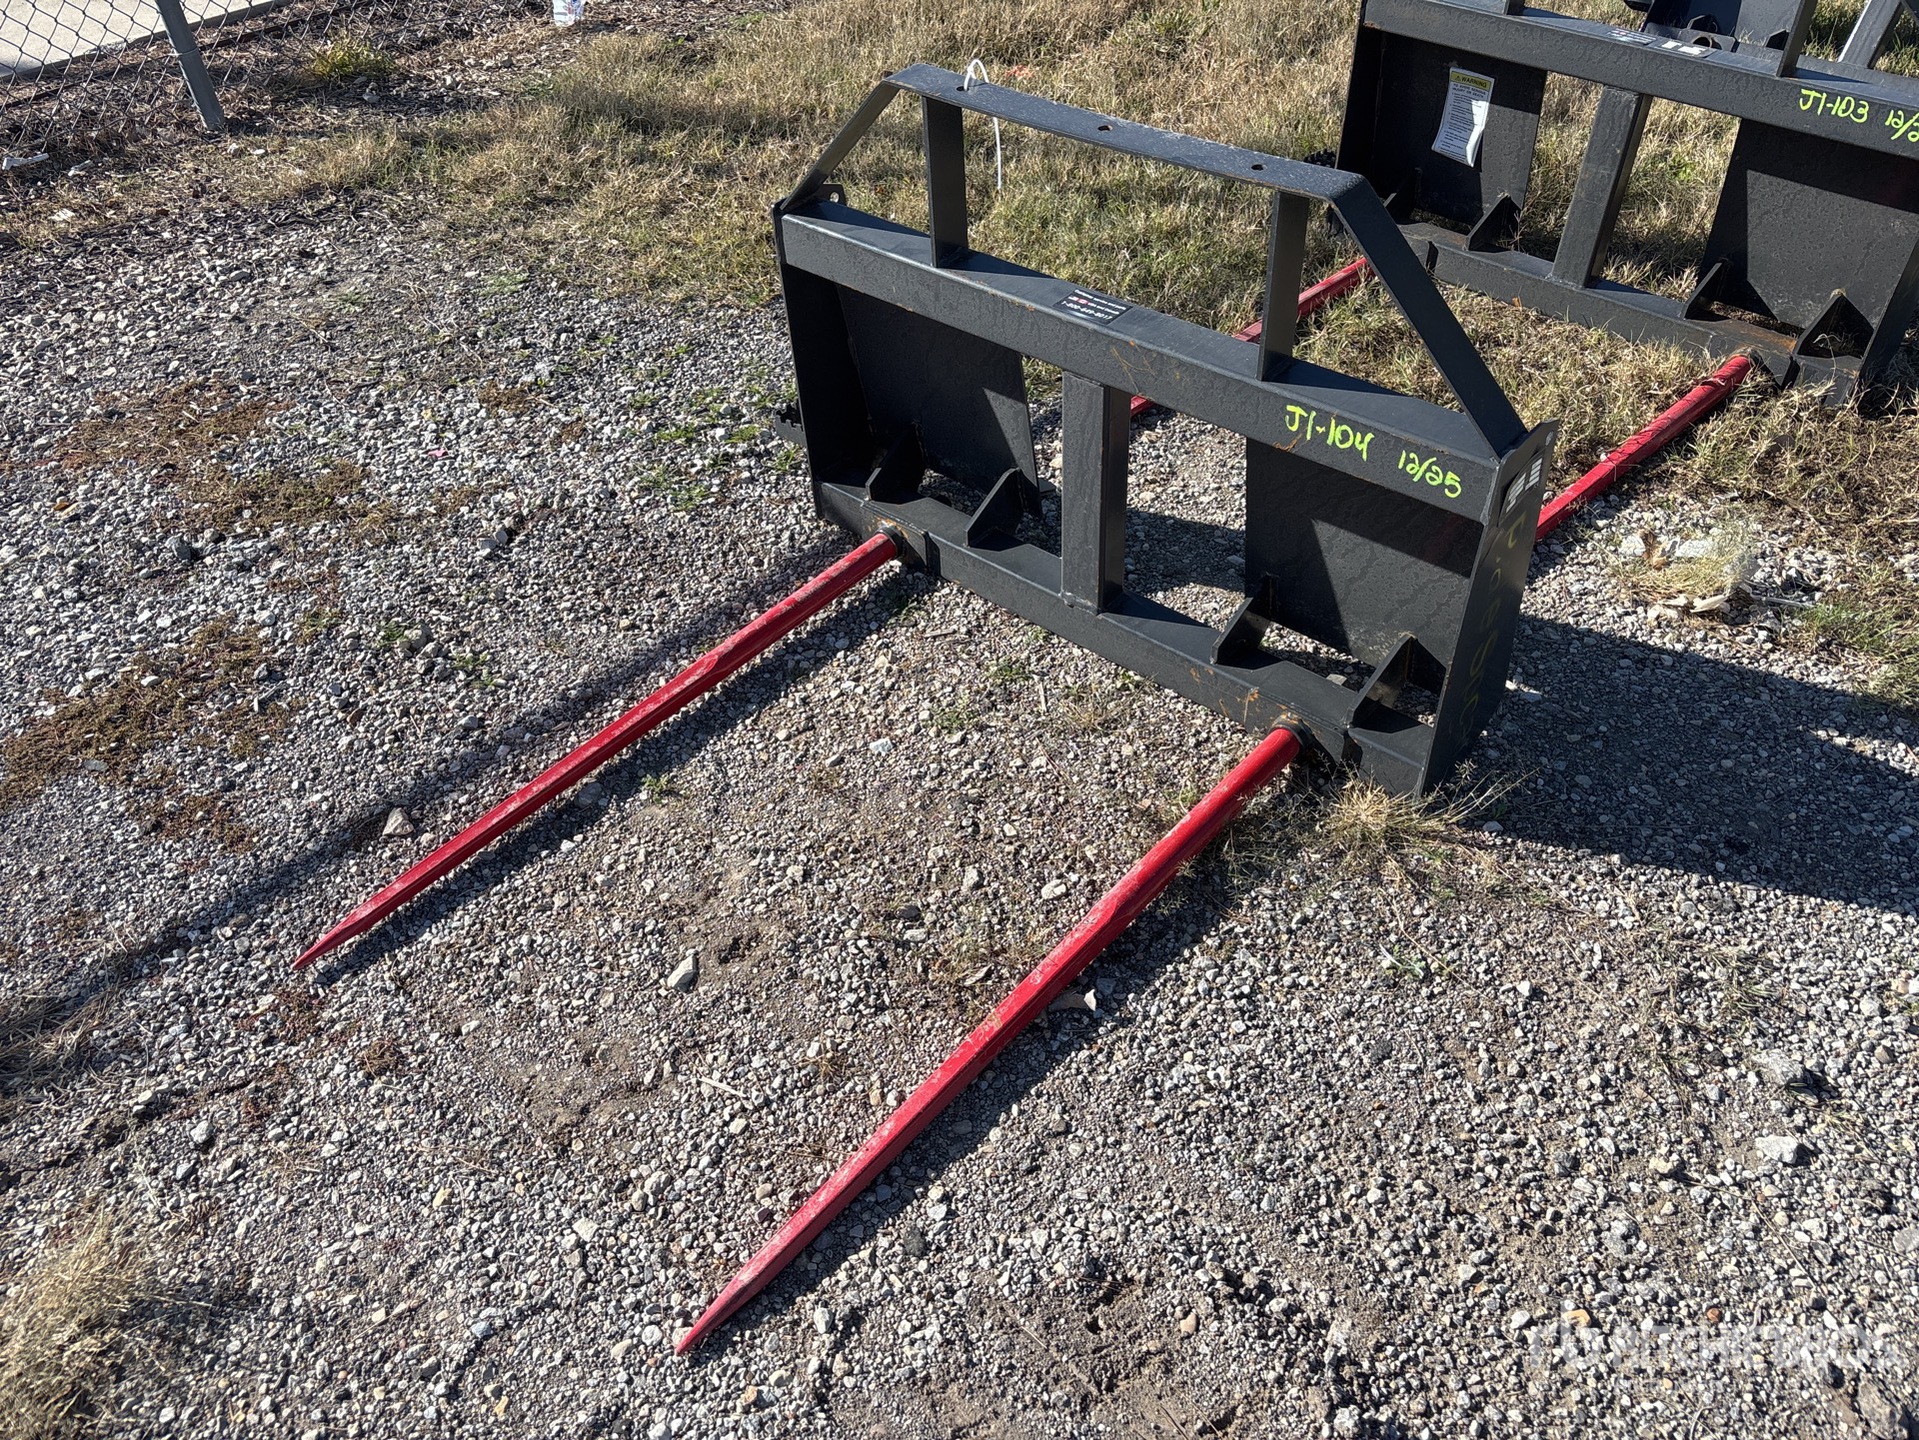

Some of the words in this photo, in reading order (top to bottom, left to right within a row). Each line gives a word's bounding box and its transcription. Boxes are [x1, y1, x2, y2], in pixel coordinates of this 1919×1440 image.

[1461, 76, 1487, 88] WARNING
[1284, 404, 1375, 462] J1-104
[1397, 449, 1462, 499] 12/25
